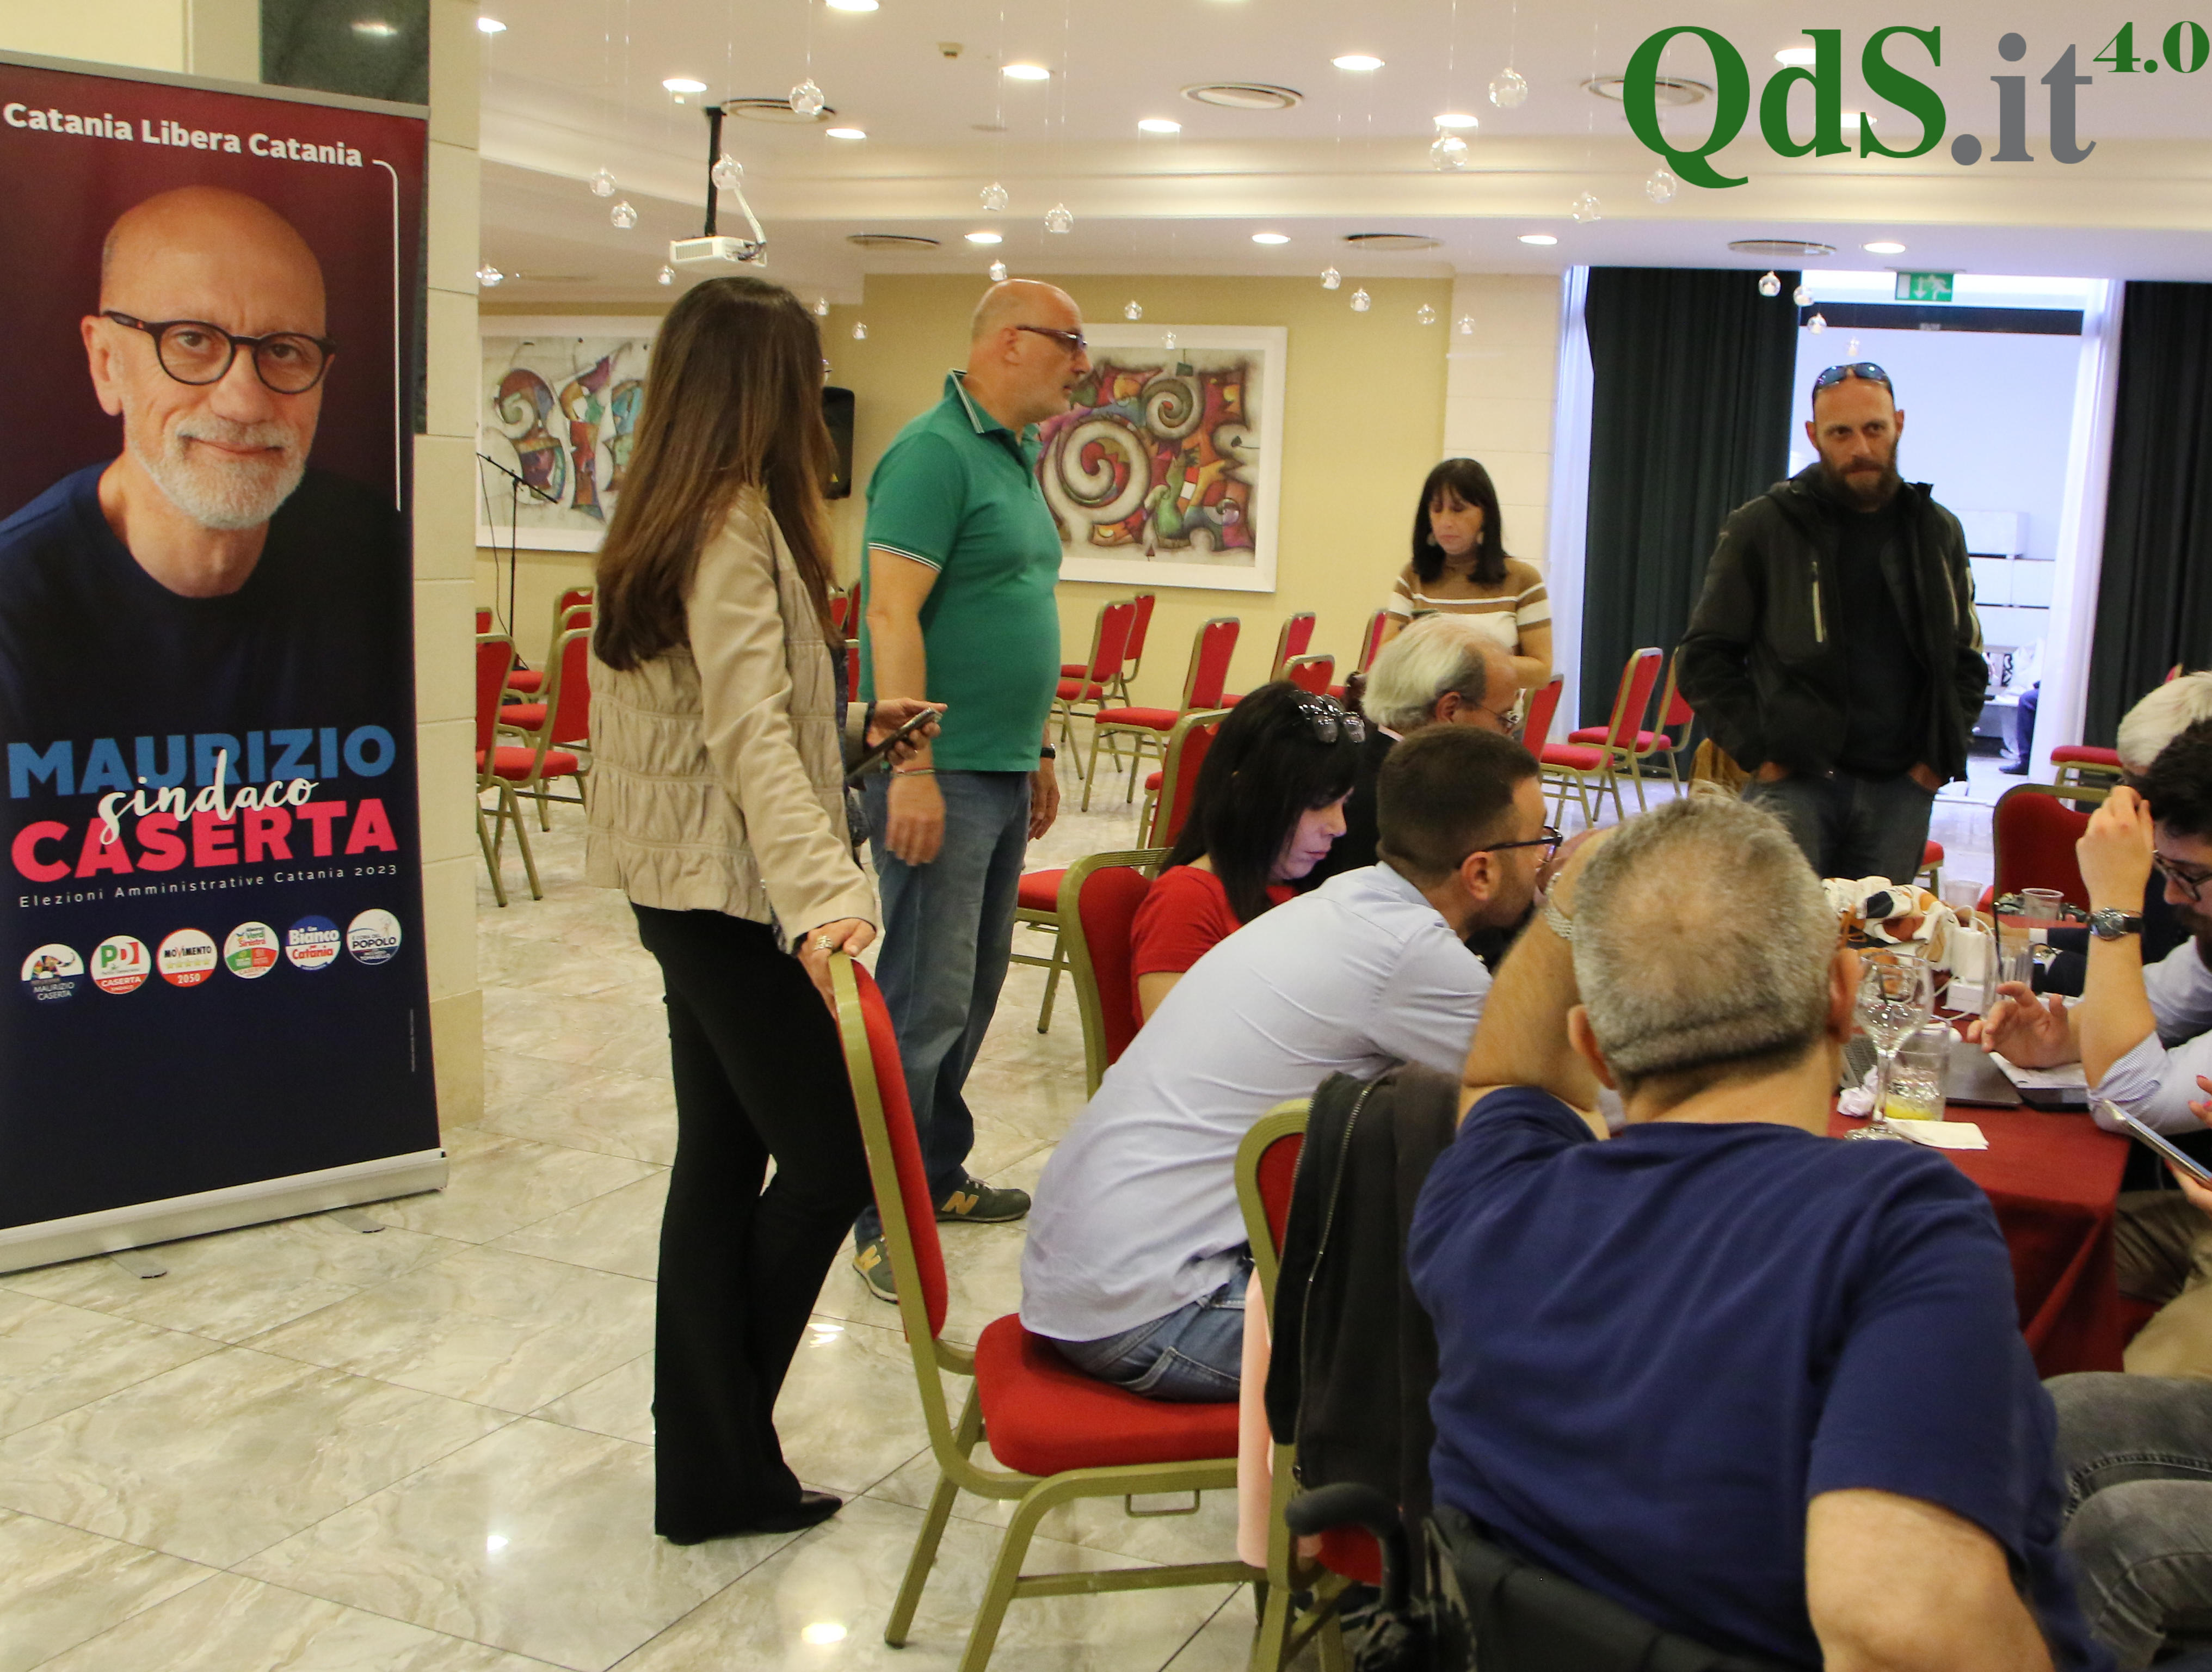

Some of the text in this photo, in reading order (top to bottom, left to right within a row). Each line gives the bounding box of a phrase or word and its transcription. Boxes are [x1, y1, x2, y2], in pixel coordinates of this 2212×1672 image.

[3, 102, 363, 167] Catania Libera Catania
[7, 724, 396, 799] MAURIZIO
[98, 748, 319, 845] sindaco
[11, 798, 398, 882] CASERTA
[20, 864, 397, 908] Elezioni Amministrative Catania 2023
[289, 928, 340, 945] Bianco
[353, 937, 397, 949] POPOLO
[101, 942, 139, 968] PD
[164, 945, 212, 958] MOVIMENTO
[293, 945, 333, 959] Catania
[101, 976, 141, 987] CASERTA
[177, 973, 201, 984] 2050
[942, 1191, 979, 1215] N
